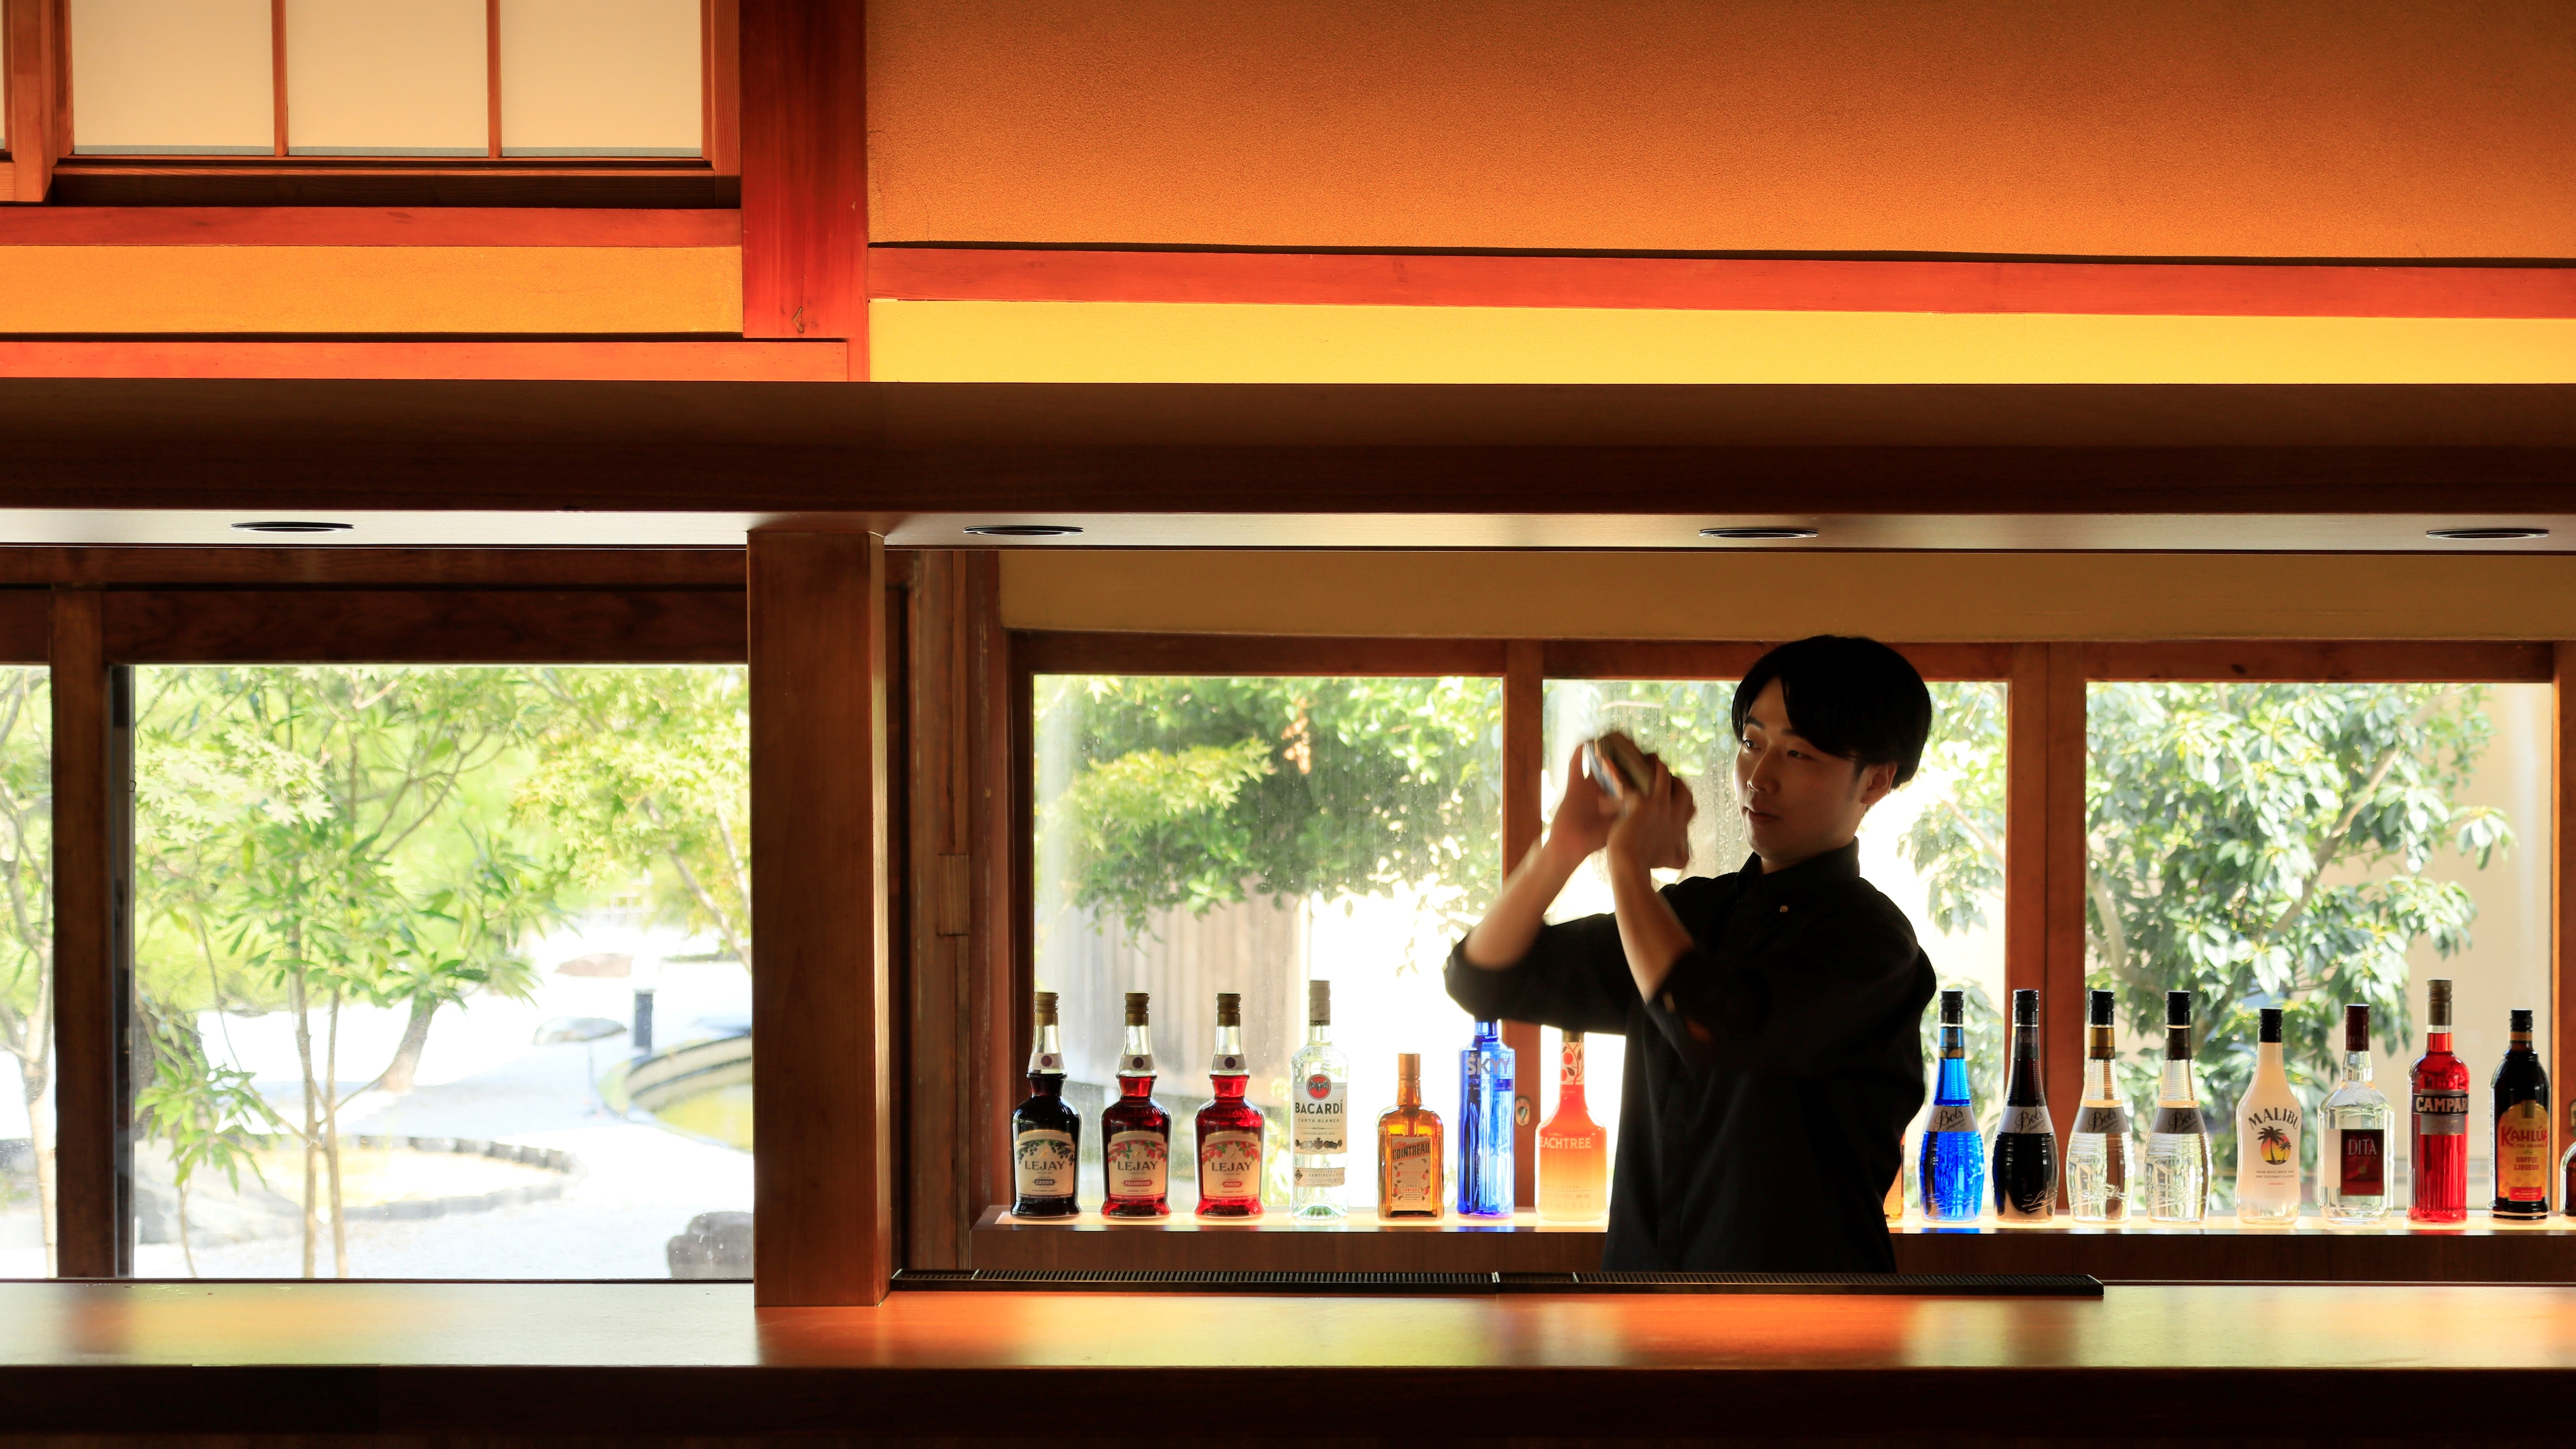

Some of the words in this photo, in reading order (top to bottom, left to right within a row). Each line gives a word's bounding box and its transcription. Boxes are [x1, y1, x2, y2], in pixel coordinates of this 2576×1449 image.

[1467, 1058, 1510, 1076] SKYY
[1295, 1099, 1343, 1114] BACARDÍ
[2248, 1107, 2300, 1130] MALIBU
[1540, 1136, 1591, 1149] EACHTREE
[2501, 1126, 2548, 1147] KAHLÚA
[1393, 1143, 1430, 1160] COINTREAU
[2348, 1139, 2377, 1155] DITA
[1025, 1161, 1065, 1170] LEJAY
[1117, 1161, 1158, 1171] LEJAY
[1211, 1162, 1252, 1172] LEJAY
